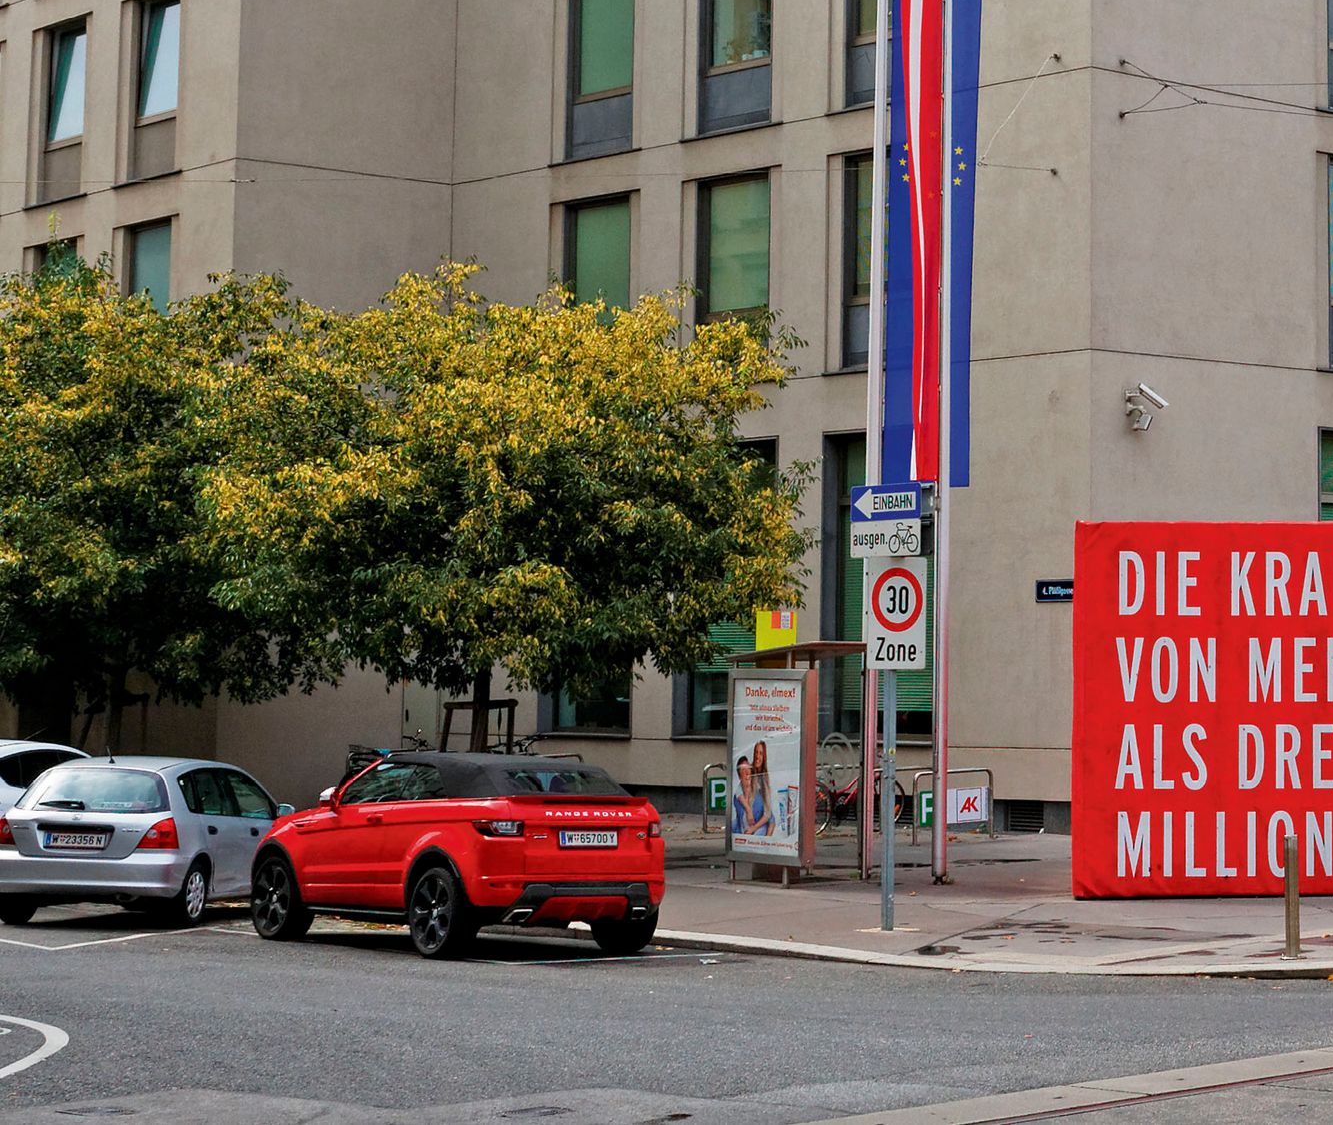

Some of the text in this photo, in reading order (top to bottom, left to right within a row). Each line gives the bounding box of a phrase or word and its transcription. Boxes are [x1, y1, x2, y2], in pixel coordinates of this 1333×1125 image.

[873, 494, 913, 510] EINBAHN
[853, 533, 888, 549] ausgen.
[1118, 550, 1201, 616] DIE
[886, 585, 909, 614] 30
[875, 637, 917, 661] Zone
[1115, 636, 1217, 703] VON
[745, 686, 770, 699] Danke,
[1114, 723, 1208, 791] ALS
[960, 796, 978, 813] AK
